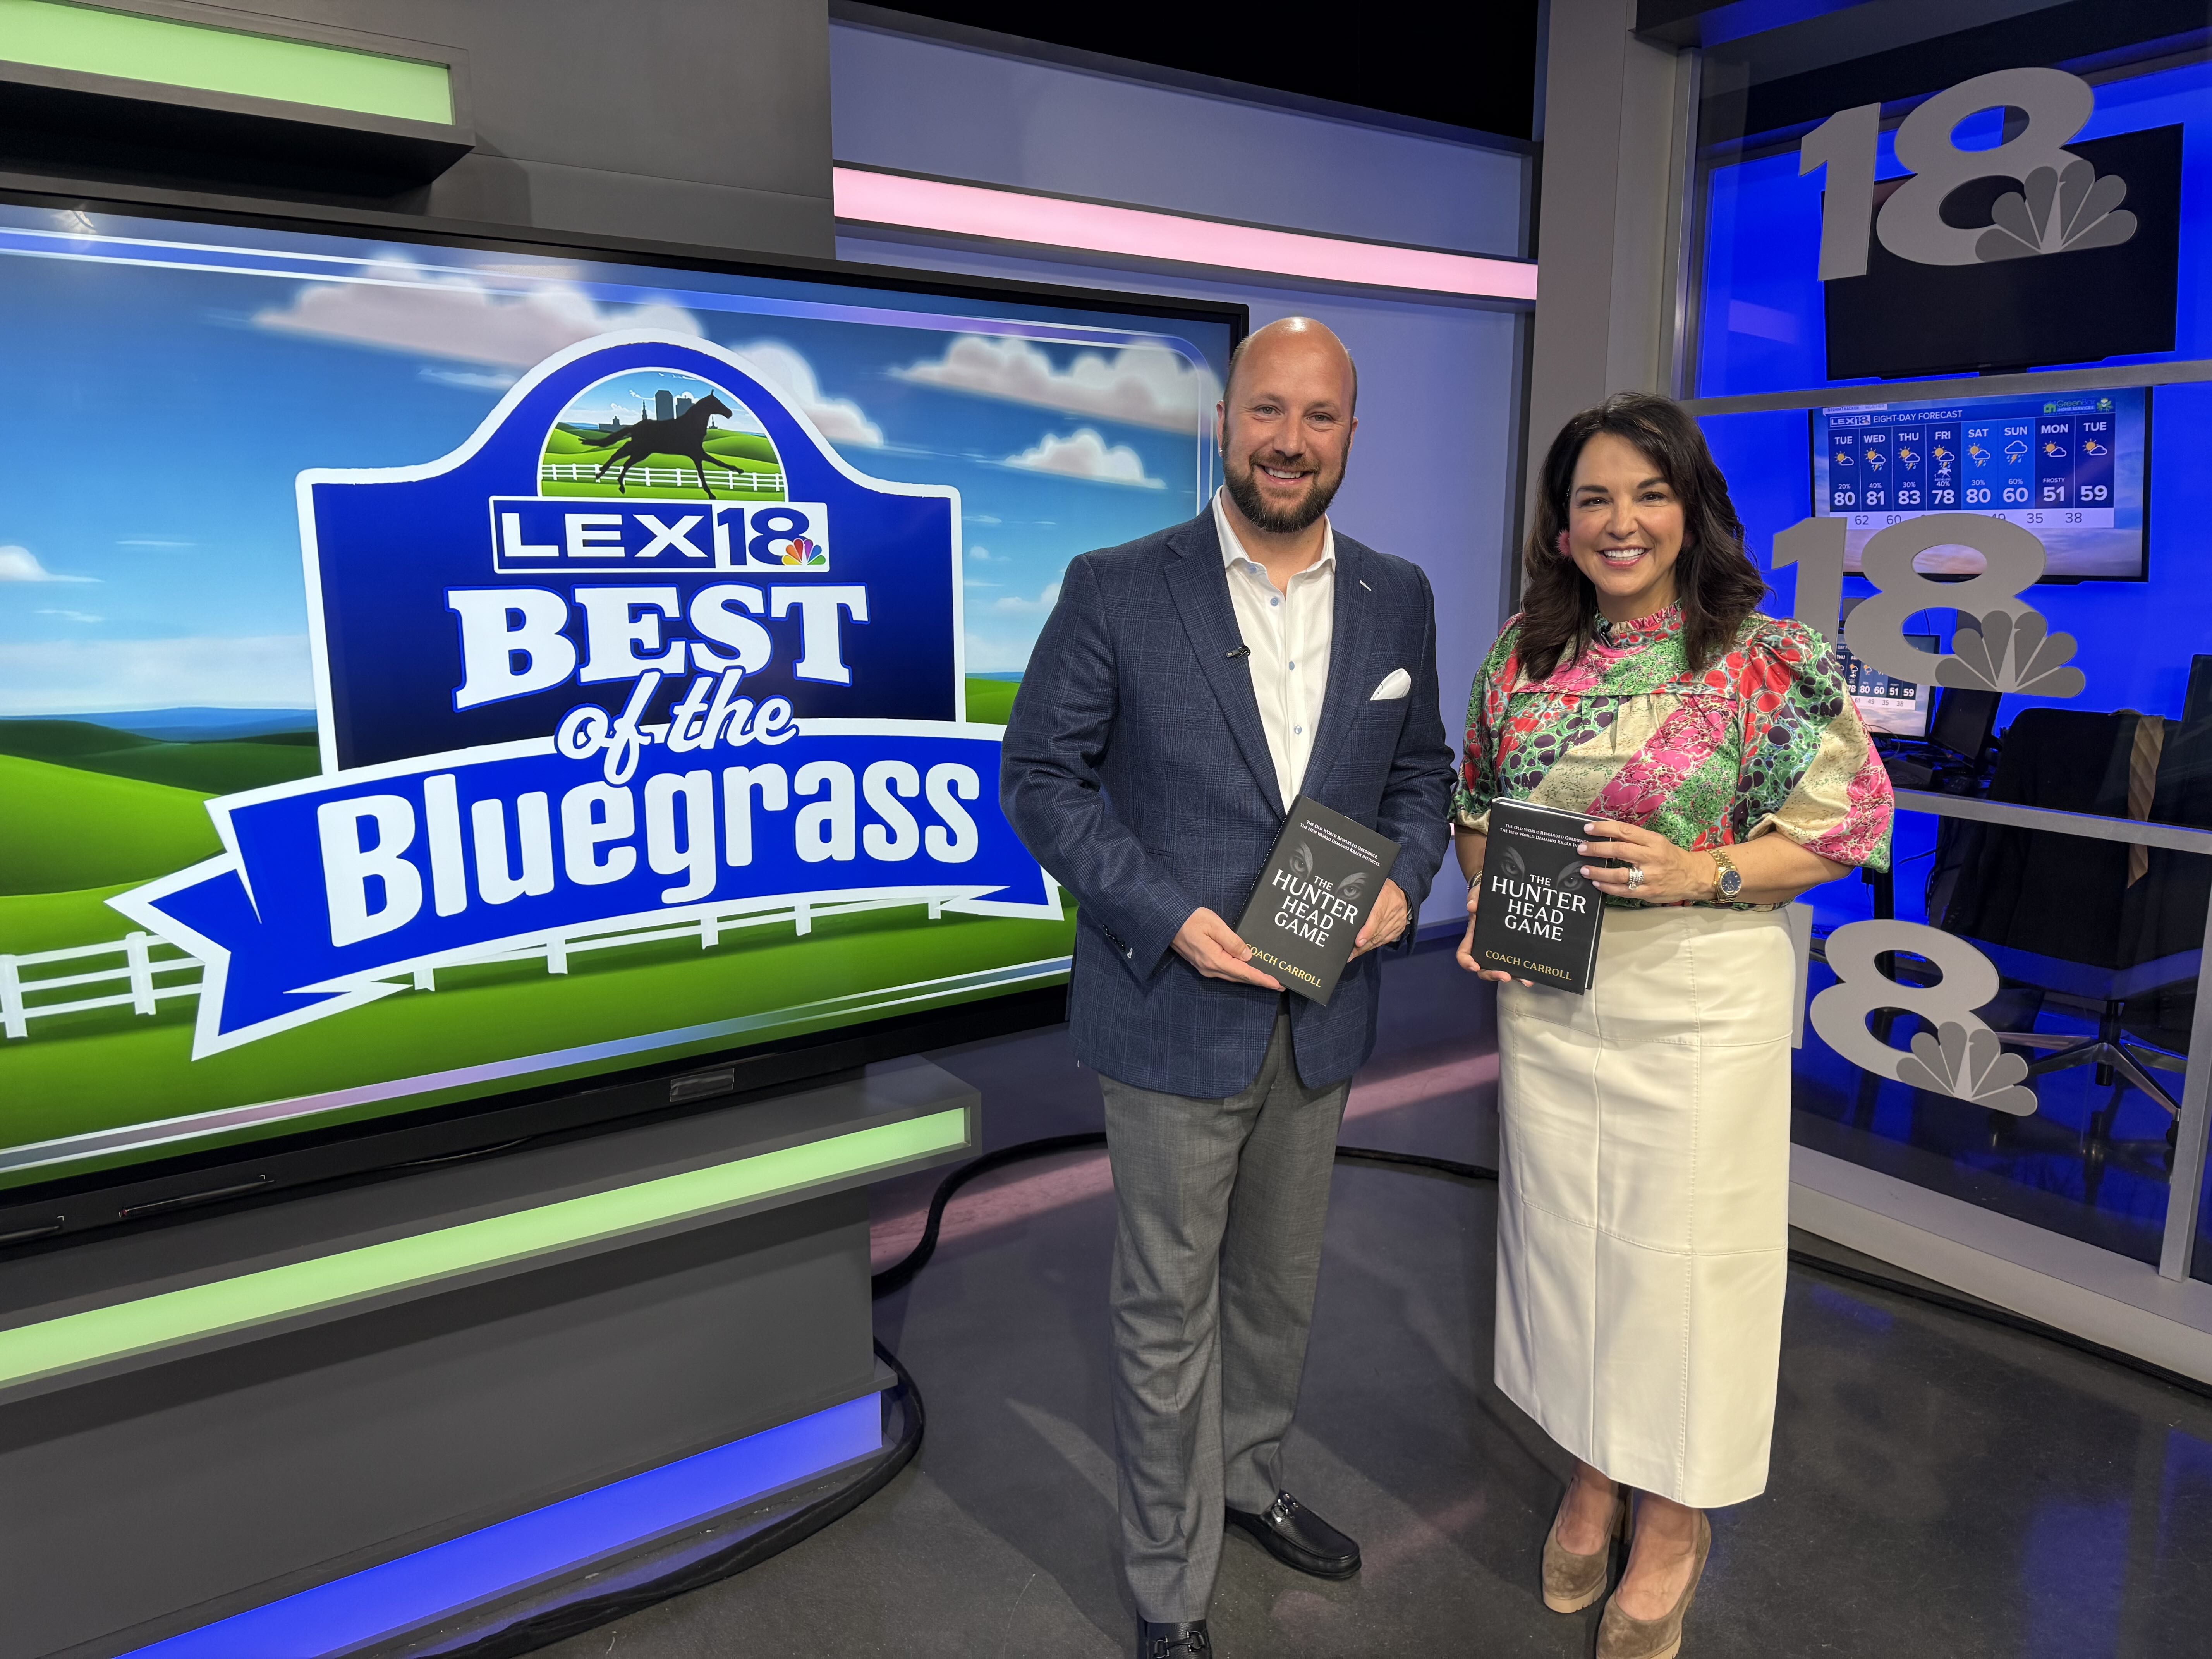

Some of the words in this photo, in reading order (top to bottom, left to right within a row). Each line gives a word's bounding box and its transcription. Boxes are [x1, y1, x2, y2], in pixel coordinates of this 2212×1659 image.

[1799, 67, 2094, 281] 18
[1874, 413, 1916, 423] EIGHT-DAY
[1918, 410, 1963, 420] FORECAST
[1834, 436, 1853, 445] TUE
[1863, 434, 1886, 443] WED
[1898, 433, 1919, 441] THU
[1935, 431, 1951, 440] FRI
[1968, 429, 1989, 438] SAT
[2004, 427, 2028, 436] SUN
[2041, 424, 2068, 434] MON
[2084, 422, 2107, 432] TUE
[1834, 491, 1856, 506] 80
[1867, 491, 1884, 505] 81
[1898, 490, 1920, 504] 83
[1932, 489, 1954, 504] 78
[1966, 488, 1991, 503] 80
[2003, 487, 2028, 503] 60
[2043, 486, 2064, 502] 51
[2081, 485, 2107, 501] 59
[1855, 515, 1869, 525] 62
[1887, 515, 1901, 525] 60
[2027, 513, 2043, 524] 35
[2065, 513, 2082, 523] 38
[1771, 513, 2047, 693] 18
[447, 583, 870, 711] BEST
[1860, 685, 1870, 694] 80
[1874, 686, 1885, 695] 60
[1889, 687, 1899, 696] 51
[1903, 688, 1914, 697] 59
[558, 669, 654, 785] of
[666, 667, 796, 750] the
[1317, 831, 1331, 842] WORLD
[1323, 828, 1337, 838] WORLD
[316, 759, 980, 949] Bluegrass
[1314, 875, 1333, 891] THE
[1530, 874, 1551, 886] THE
[1272, 869, 1358, 925] HUNTER
[1491, 876, 1587, 914] HUNTER
[1281, 895, 1334, 930] HEAD
[1508, 899, 1564, 924] HEAD
[1274, 911, 1329, 948] GAME
[1504, 915, 1564, 941] GAME
[1278, 960, 1321, 988] CARROLL
[1486, 950, 1521, 966] COACH
[1523, 960, 1572, 981] CARROLL
